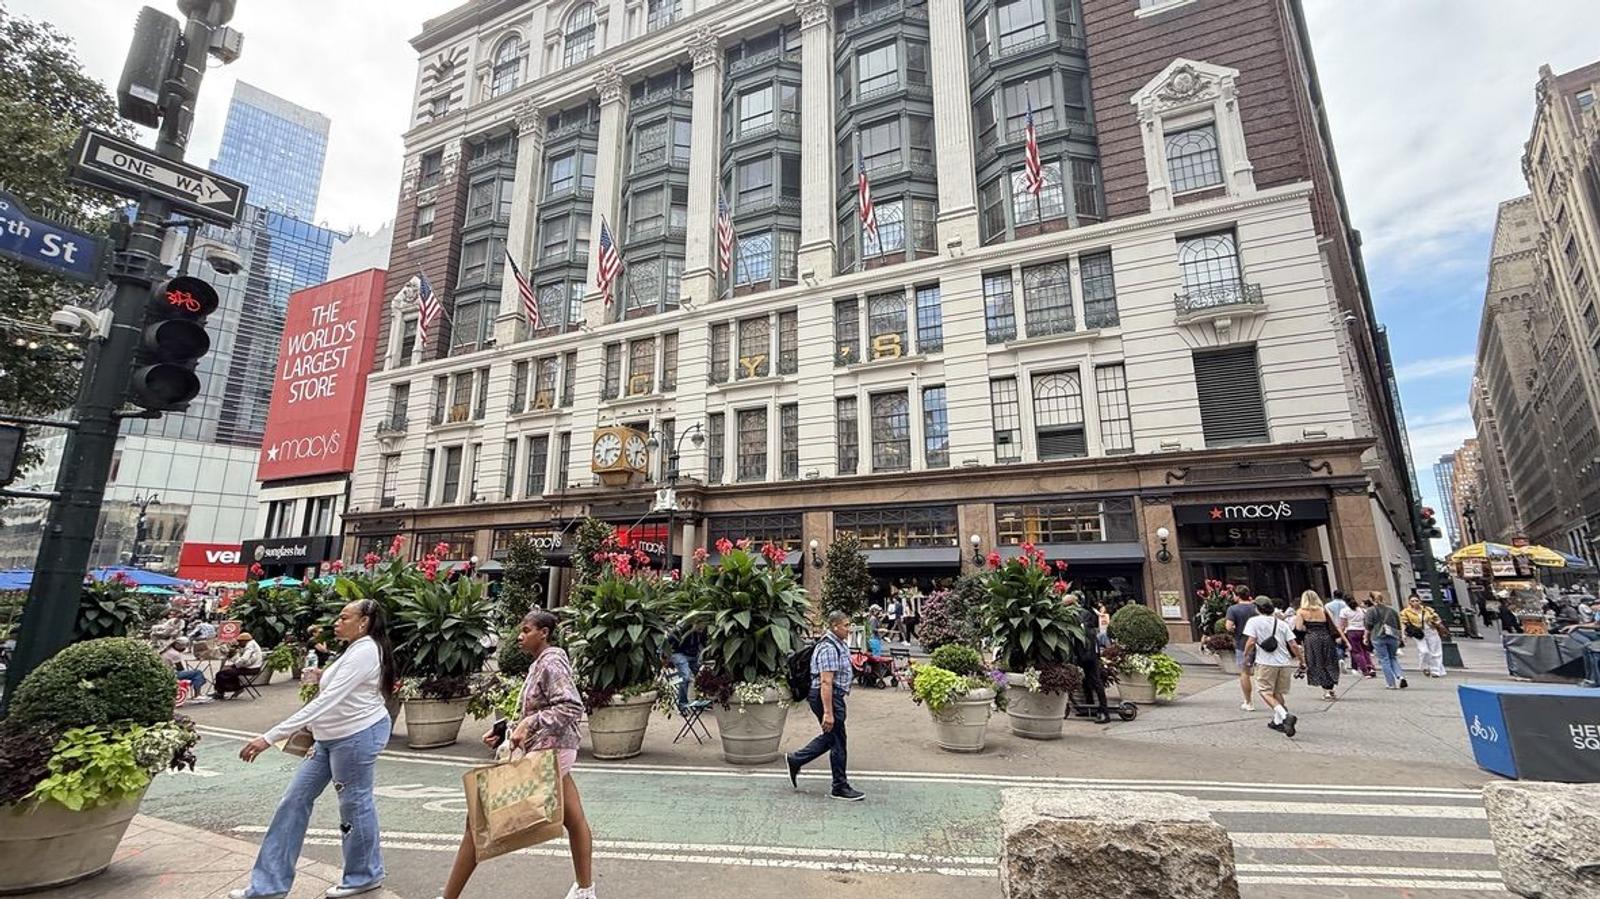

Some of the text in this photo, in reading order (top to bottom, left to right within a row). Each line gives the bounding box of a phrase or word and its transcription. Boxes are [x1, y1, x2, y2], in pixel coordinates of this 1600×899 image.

[112, 154, 219, 199] ONE WAY
[40, 233, 78, 263] St
[311, 300, 342, 327] THE
[288, 320, 357, 356] WORLD'S
[282, 345, 352, 381] LARGEST
[288, 373, 339, 404] STORE
[278, 430, 341, 461] macy's
[1224, 501, 1292, 520] macy's
[264, 545, 294, 560] sunglass
